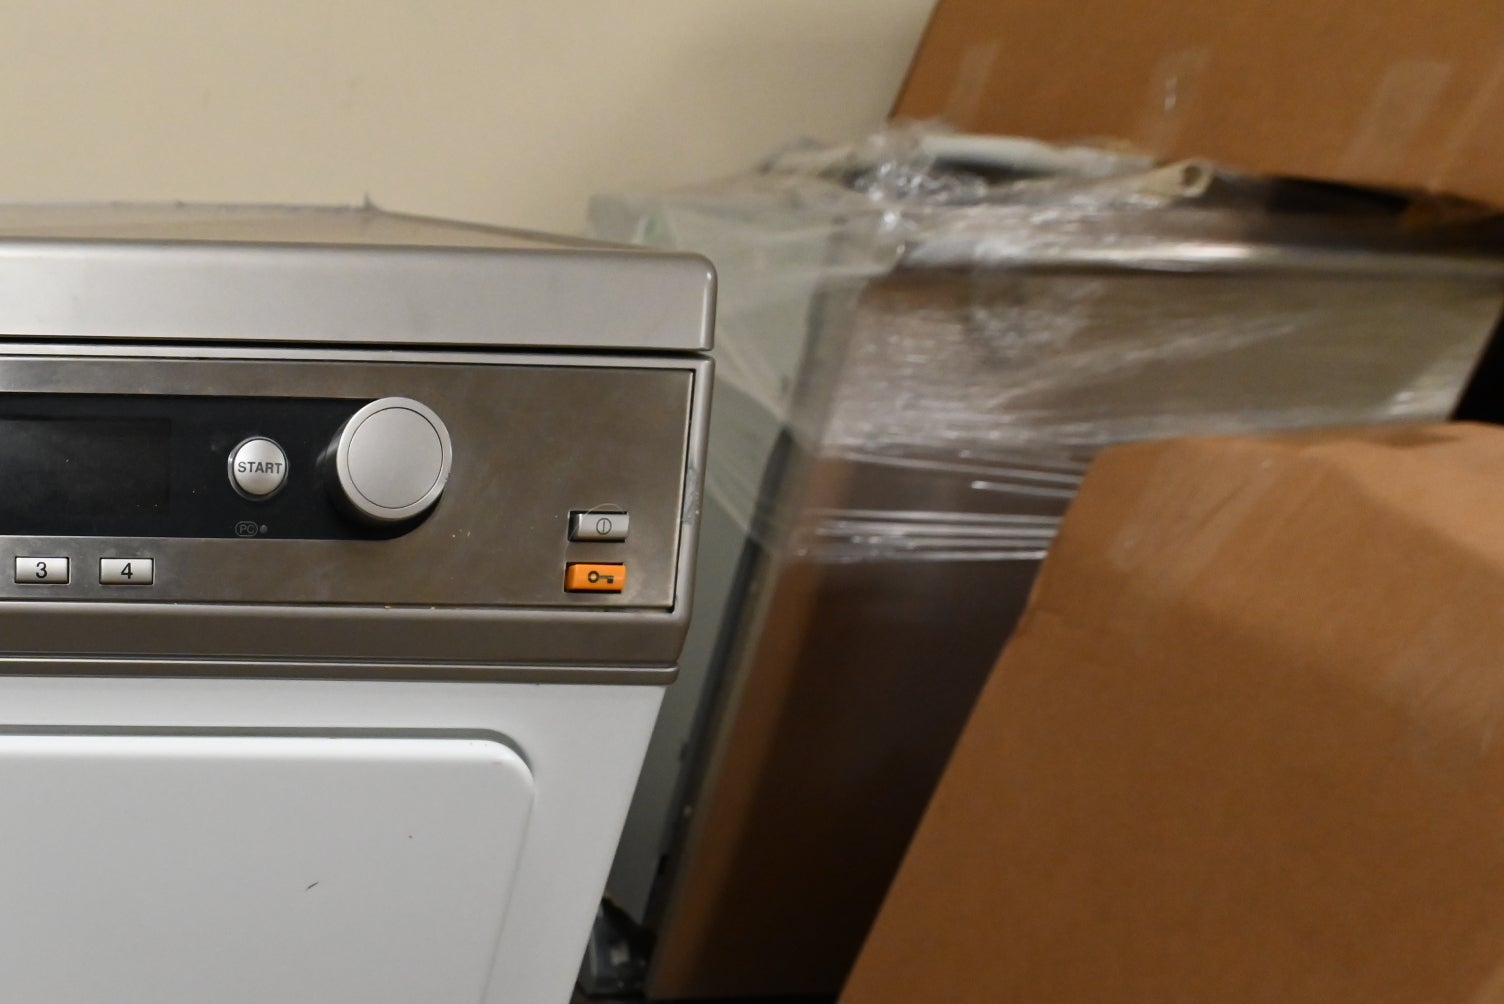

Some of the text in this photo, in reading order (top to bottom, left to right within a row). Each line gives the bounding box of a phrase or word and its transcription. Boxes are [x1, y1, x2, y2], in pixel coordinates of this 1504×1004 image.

[237, 461, 283, 475] START
[36, 561, 48, 579] 3
[120, 562, 134, 579] 4
